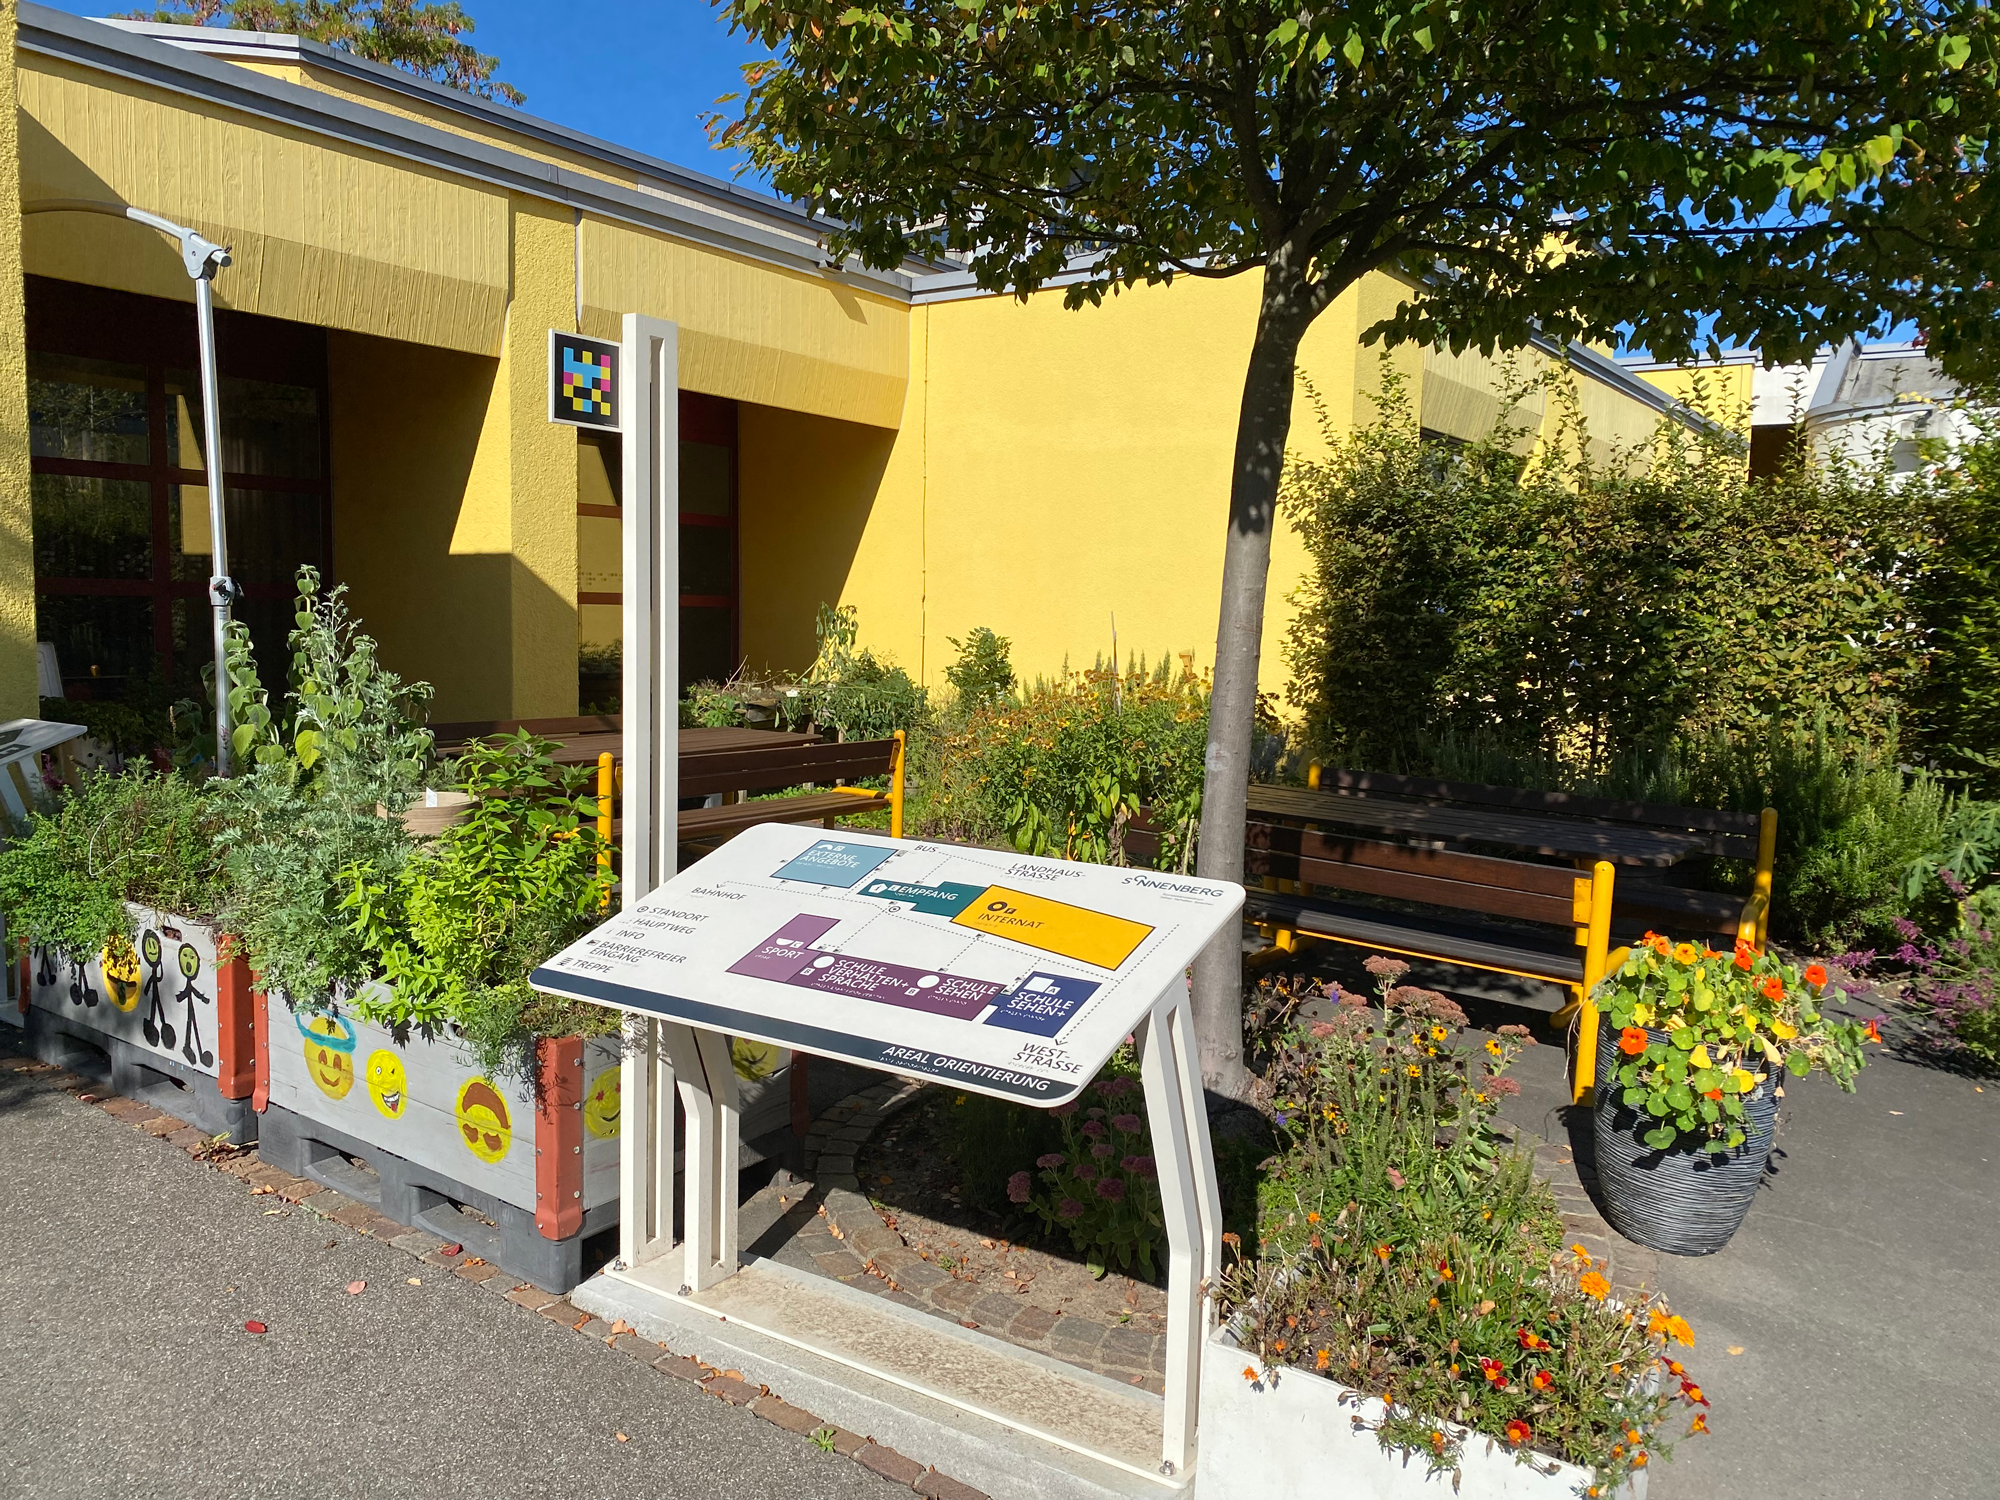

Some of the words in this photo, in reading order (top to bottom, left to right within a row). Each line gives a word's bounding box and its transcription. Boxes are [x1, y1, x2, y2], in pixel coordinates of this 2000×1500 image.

[807, 850, 858, 861] EXTERNE
[915, 845, 938, 853] BUS
[800, 856, 860, 868] ANGEBOTE
[1005, 869, 1060, 881] STRASSE
[1012, 863, 1087, 878] LANDHAUS-
[691, 887, 747, 900] BAHNHOF
[899, 886, 958, 900] EMPFANG
[649, 907, 709, 922] STANDORT
[978, 914, 1045, 929] INTERNAT
[633, 918, 696, 935] HAUPTWEG
[616, 930, 645, 940] INFO
[589, 948, 642, 963] EINGANG
[599, 941, 687, 964] BARRIEREFREIER
[761, 946, 805, 960] SPORT
[573, 959, 614, 974] TREPPE
[834, 959, 887, 975] SCHULE
[818, 974, 879, 991] SPRACHE
[942, 979, 999, 995] SCHULE
[935, 986, 984, 1001] SEHEN
[1015, 992, 1074, 1010] SCHULE
[1023, 1043, 1070, 1059] WEST-
[882, 1046, 930, 1064] AREAL
[933, 1057, 1050, 1092] ORIENTIERUNG
[1013, 1052, 1083, 1074] STRASSE
